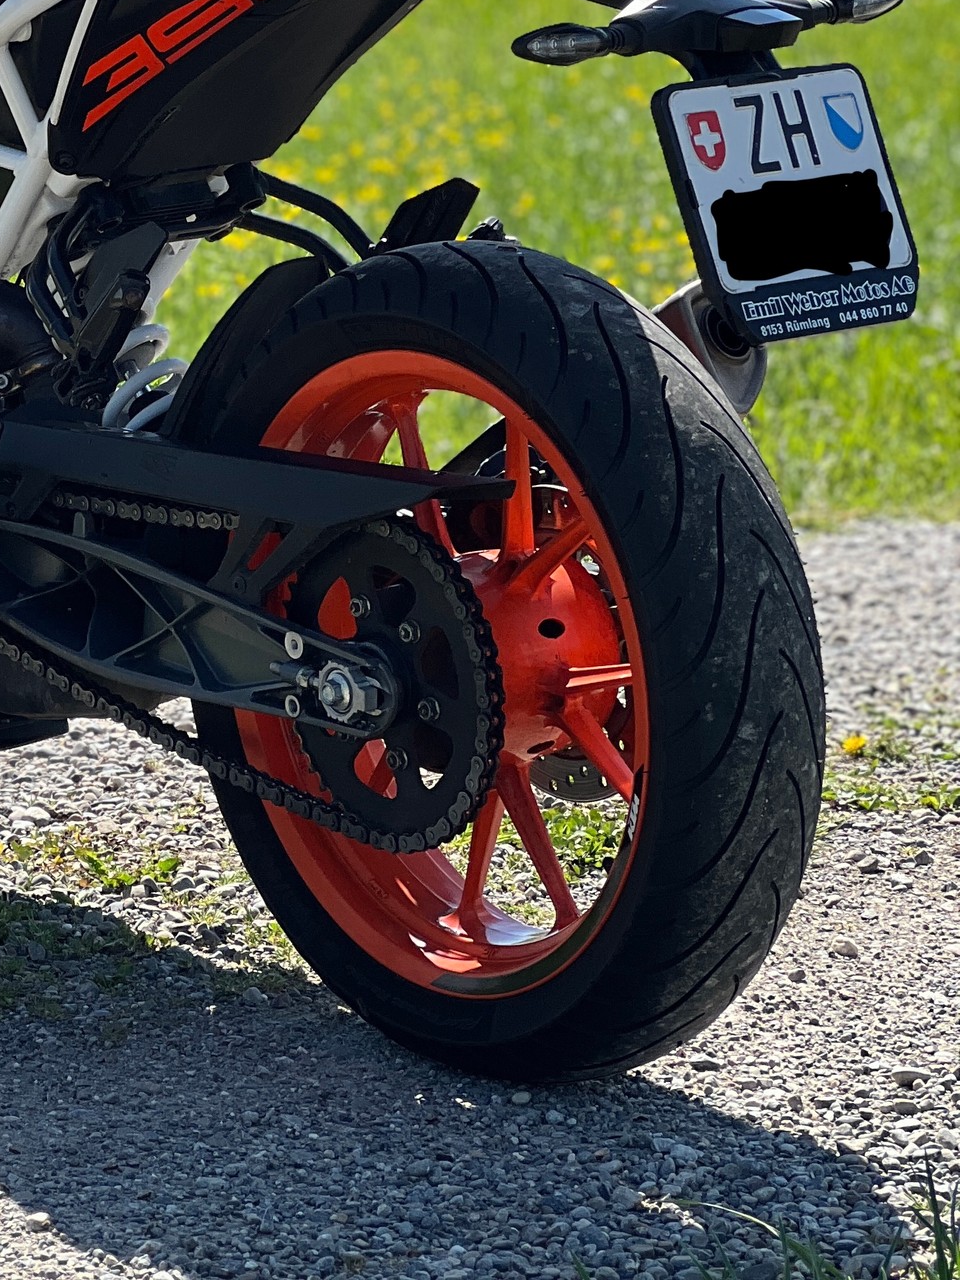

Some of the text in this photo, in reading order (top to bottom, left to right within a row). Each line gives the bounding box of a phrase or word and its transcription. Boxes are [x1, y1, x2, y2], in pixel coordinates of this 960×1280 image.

[733, 89, 821, 174] ZH
[741, 275, 916, 321] Emil Weber Motos AG
[760, 302, 909, 337] 8153 Rümlang 044 860 77 40
